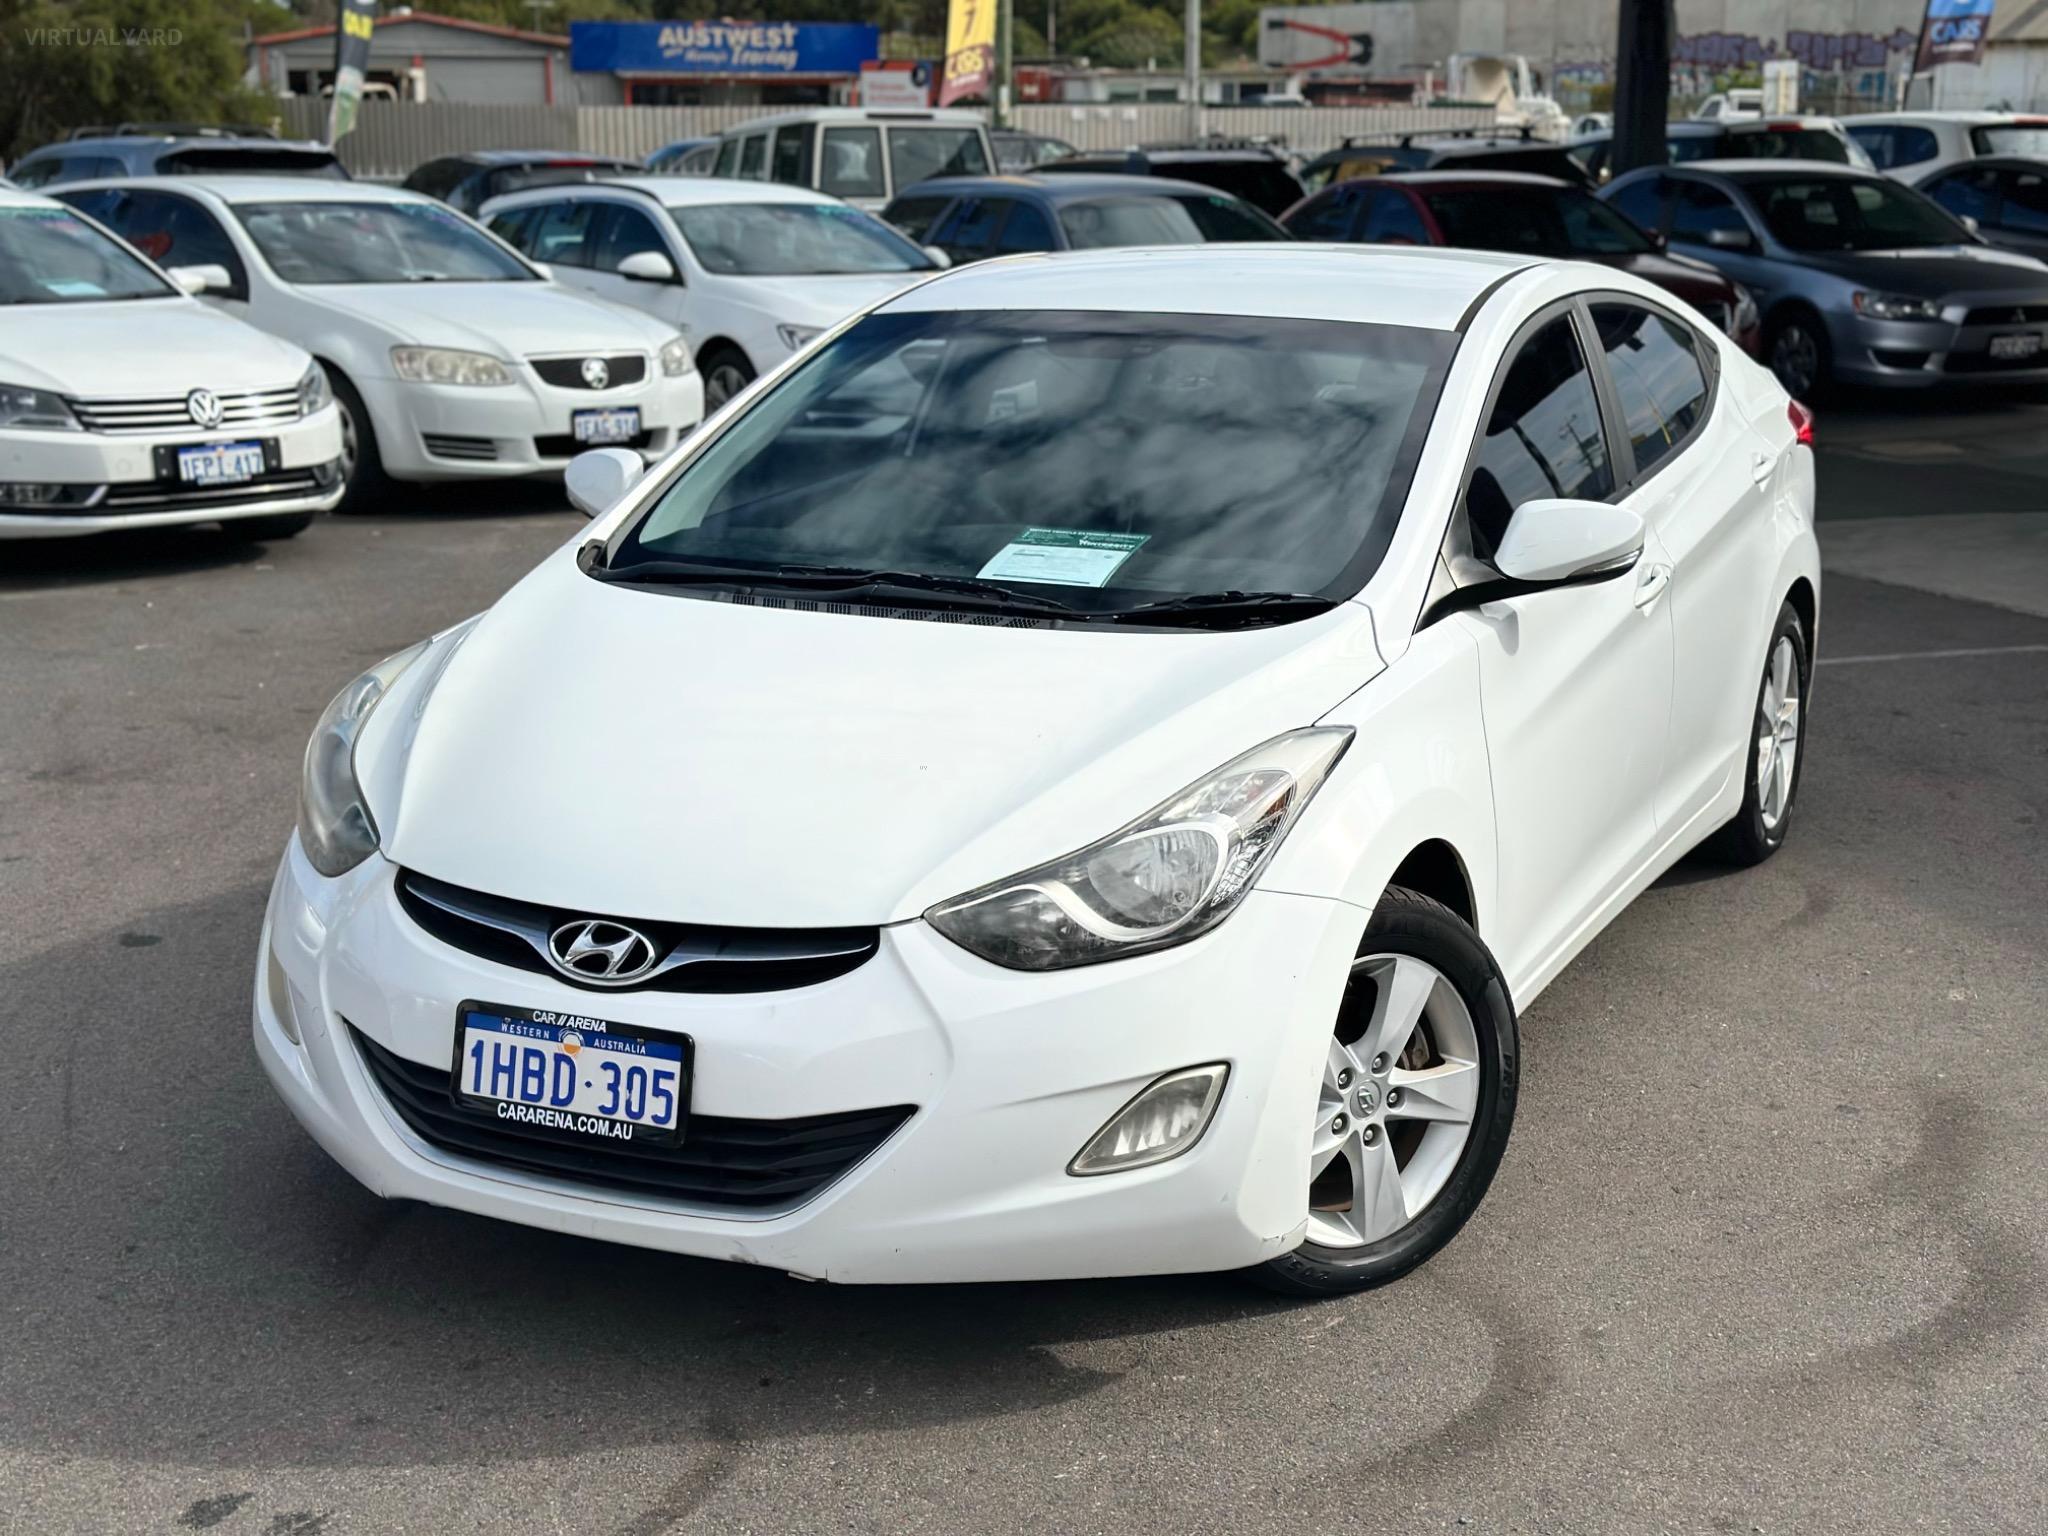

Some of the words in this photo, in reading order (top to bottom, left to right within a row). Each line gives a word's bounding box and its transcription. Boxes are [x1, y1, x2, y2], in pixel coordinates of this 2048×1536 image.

[658, 22, 799, 49] AUSTWEST
[501, 1022, 551, 1040] WESTERN
[593, 1037, 647, 1055] AUSTRALIA
[497, 1102, 633, 1141] CARARENA.COM.AU
